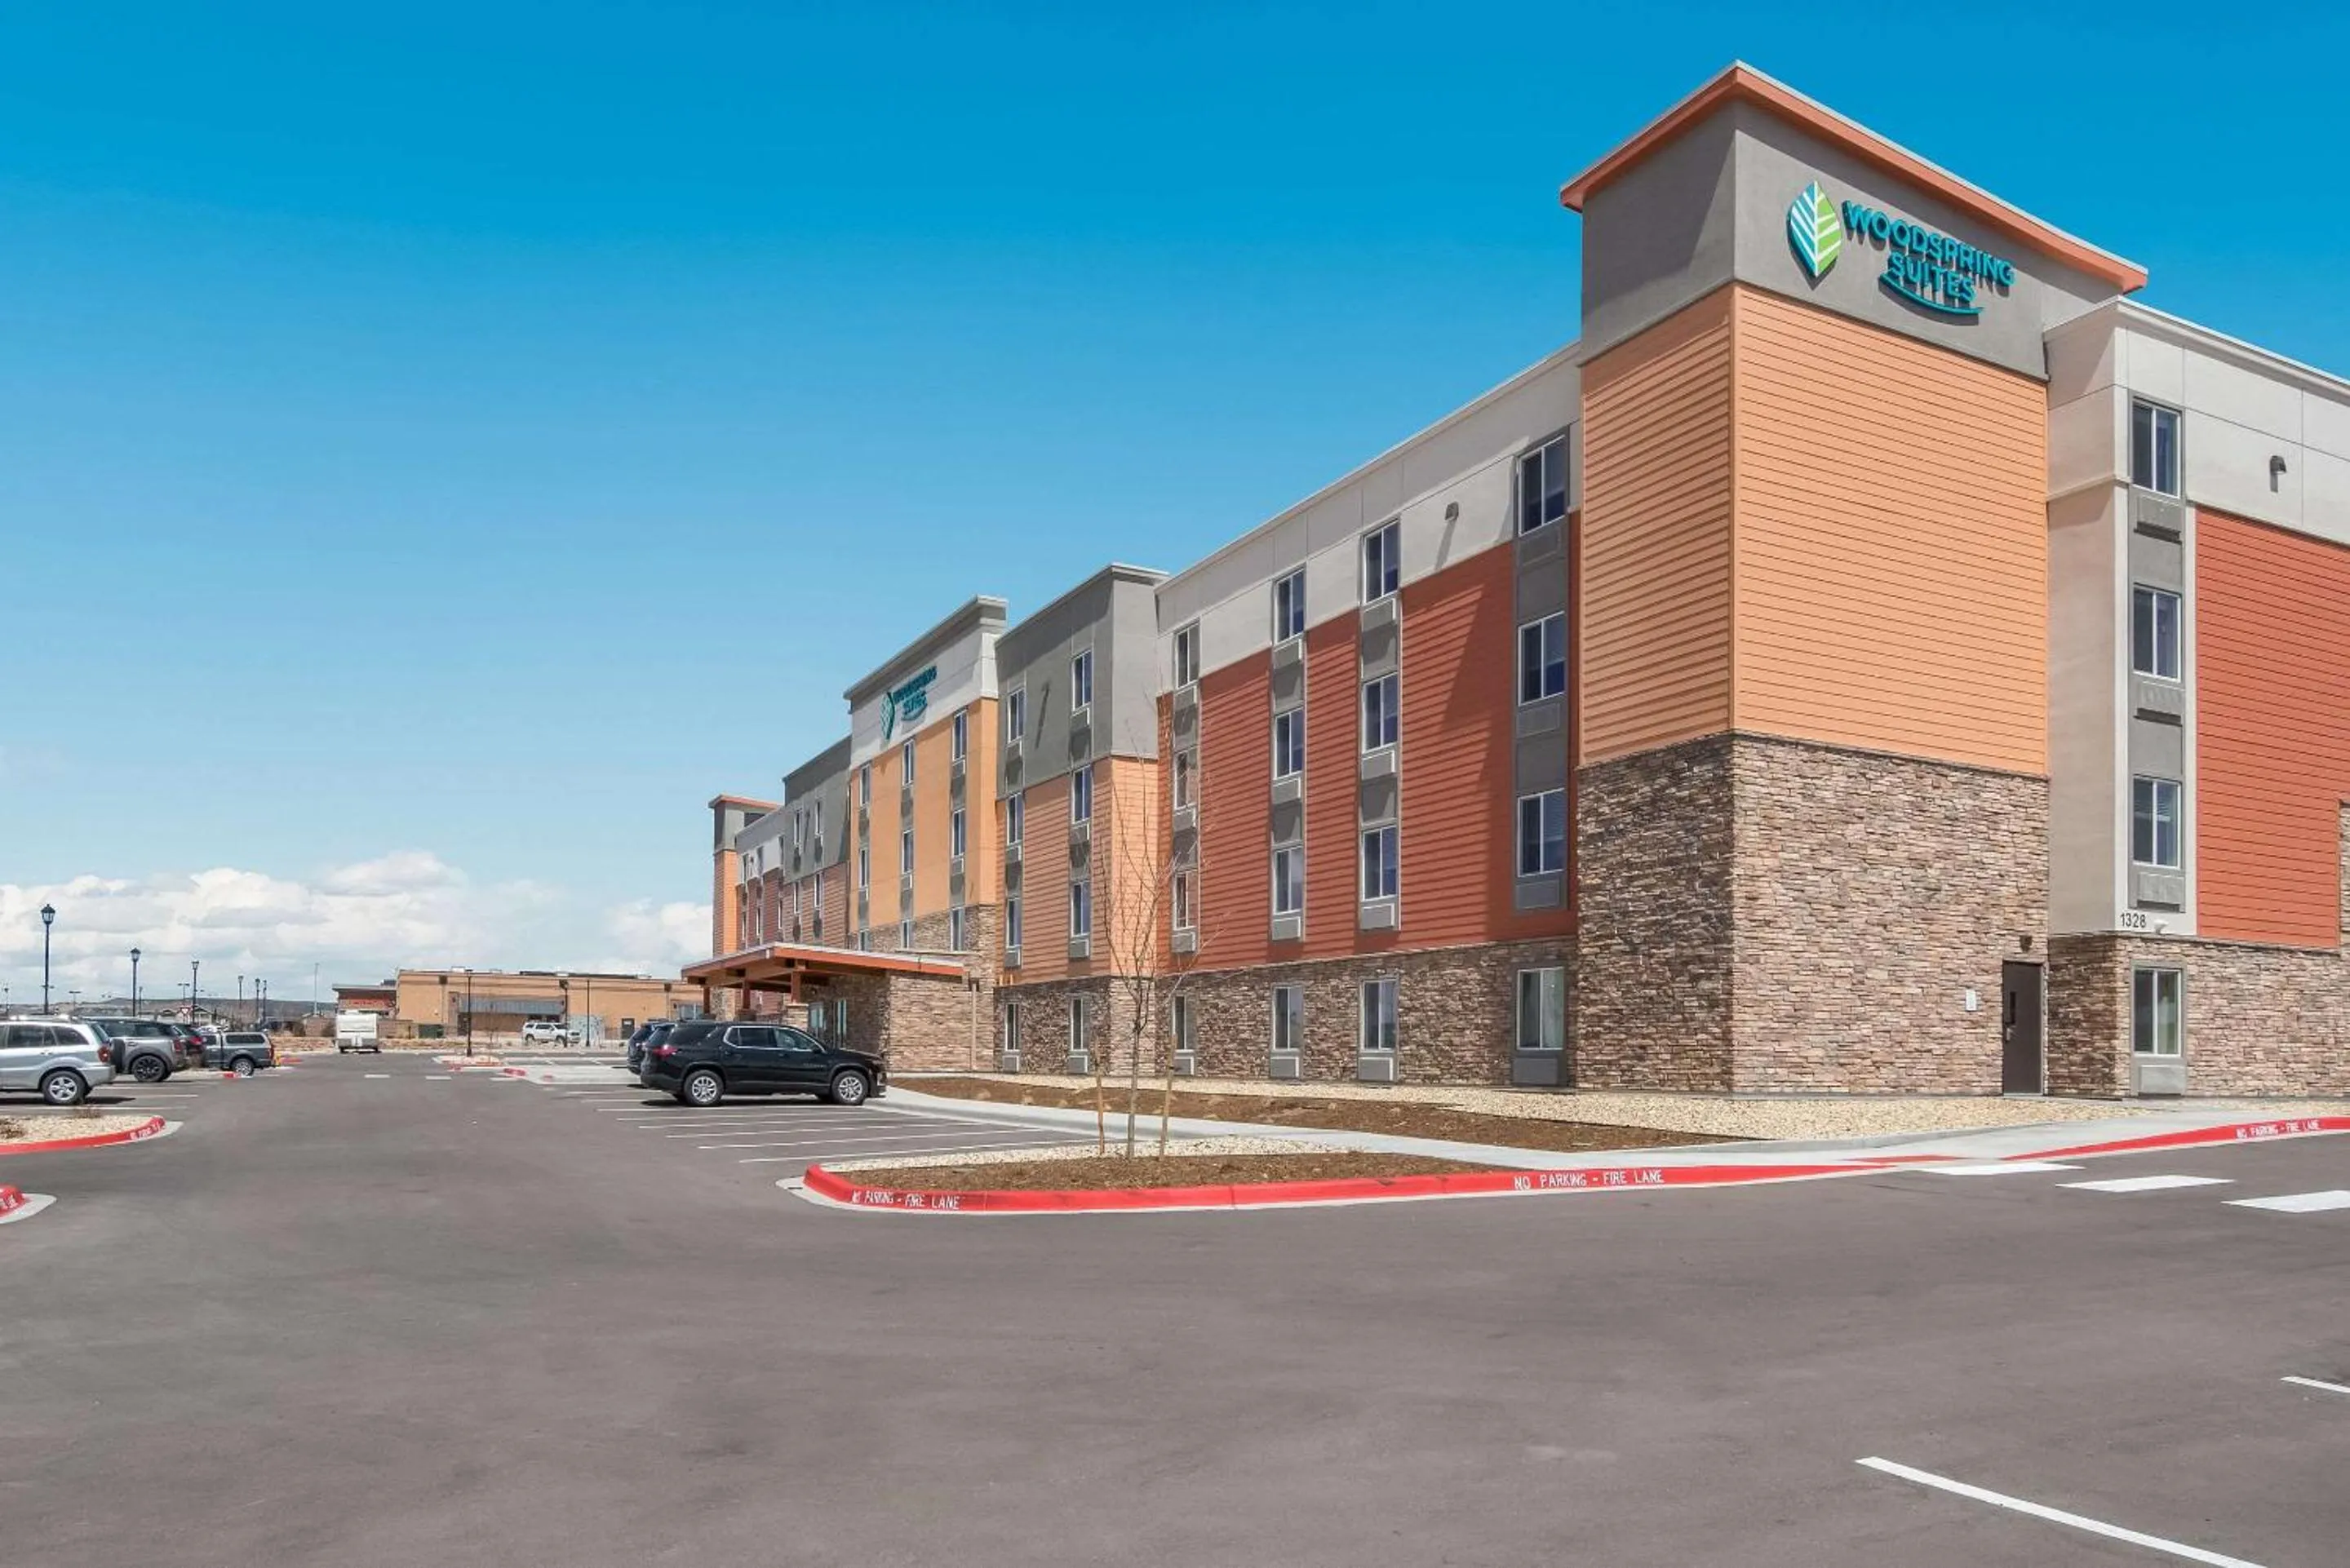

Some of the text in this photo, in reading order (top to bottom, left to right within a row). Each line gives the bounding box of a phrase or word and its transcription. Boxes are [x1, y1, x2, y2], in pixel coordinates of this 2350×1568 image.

[1842, 200, 2015, 286] WOODSPRING
[1888, 250, 1976, 302] SUITES
[2121, 913, 2146, 928] 1328
[1514, 1176, 1531, 1190] NO
[1540, 1173, 1587, 1188] PARKING
[1603, 1171, 1627, 1185] FIRE
[1634, 1169, 1664, 1184] LANE
[931, 1195, 960, 1210] LANE
